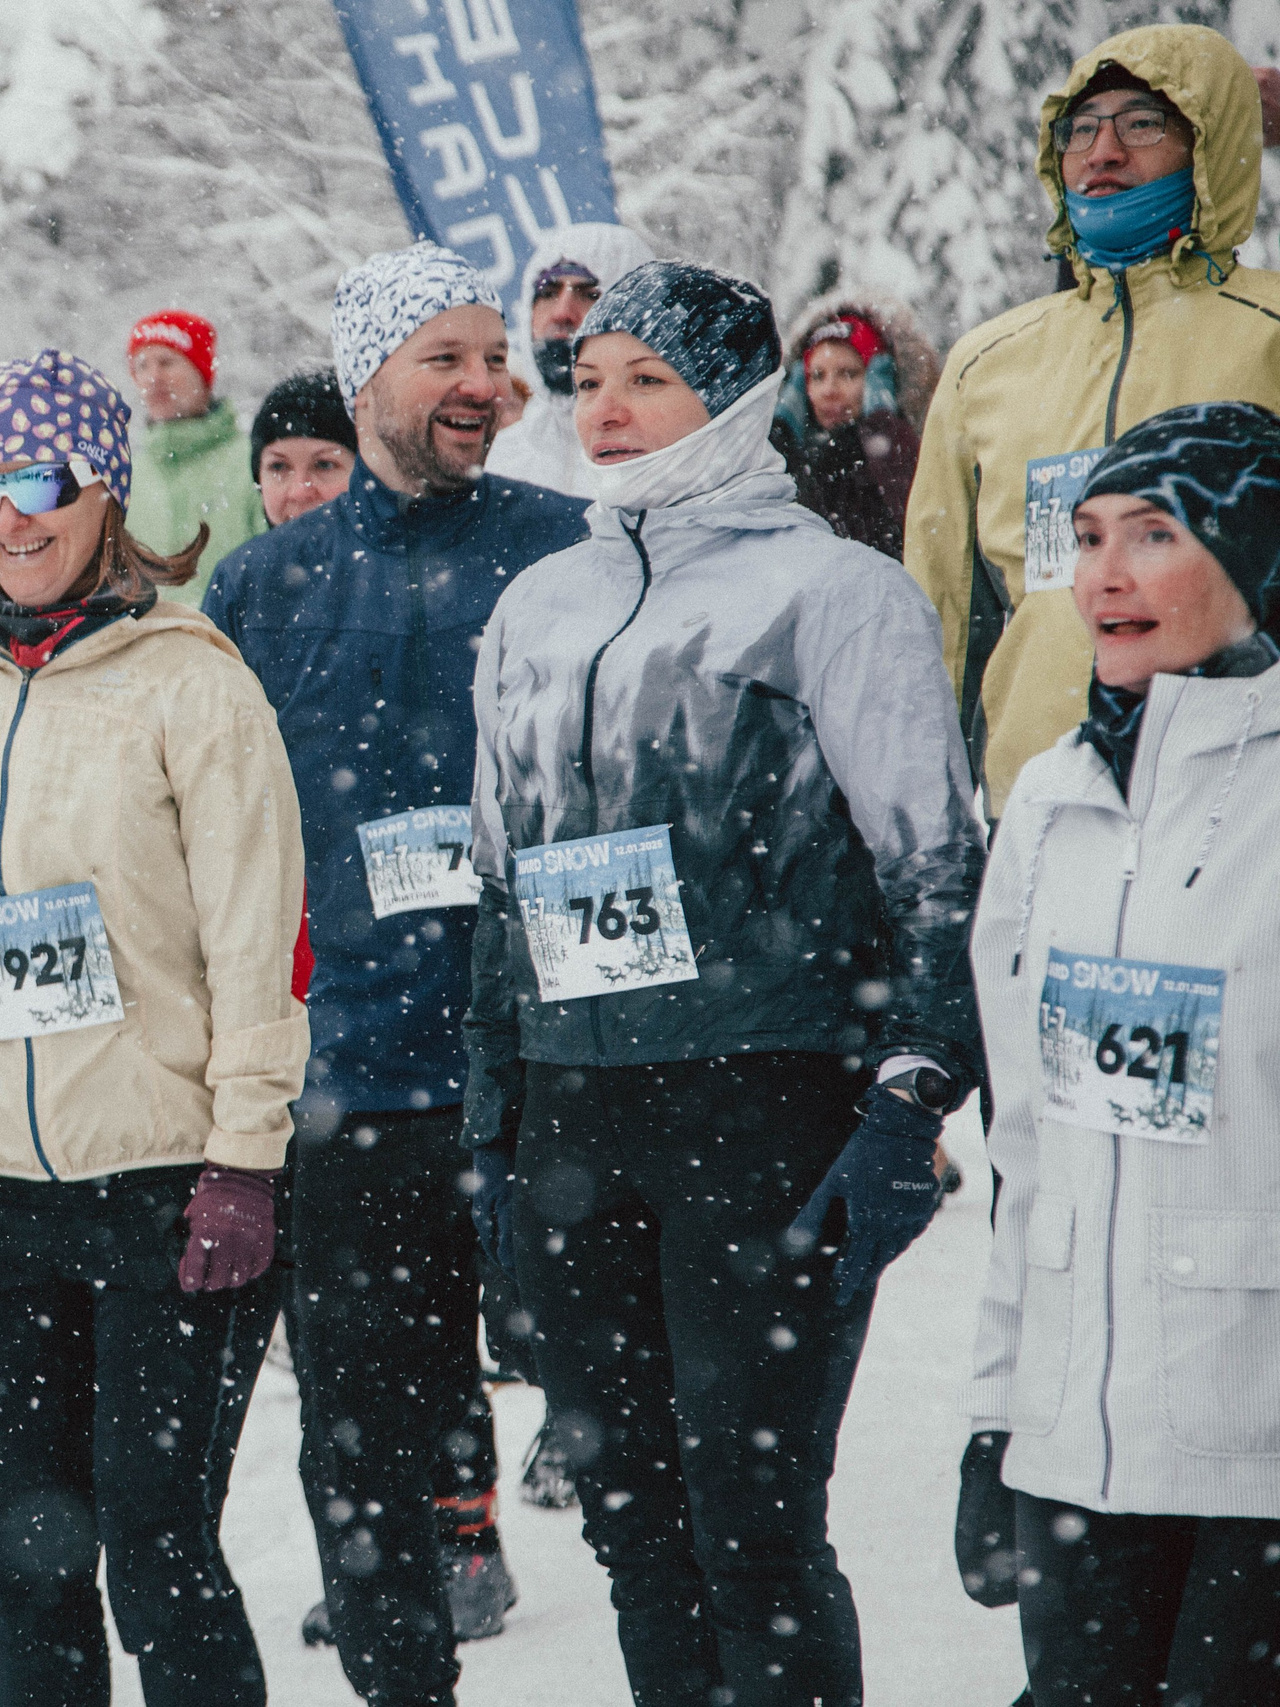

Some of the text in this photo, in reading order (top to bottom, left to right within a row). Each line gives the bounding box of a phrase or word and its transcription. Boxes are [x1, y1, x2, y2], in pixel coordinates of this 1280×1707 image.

[1069, 452, 1101, 479] SN
[543, 840, 610, 875] SNOW
[569, 886, 662, 945] 763
[3, 936, 87, 991] 927
[1073, 960, 1160, 996] SNOW
[1096, 1023, 1190, 1084] 621
[892, 1180, 933, 1191] DEWAY
